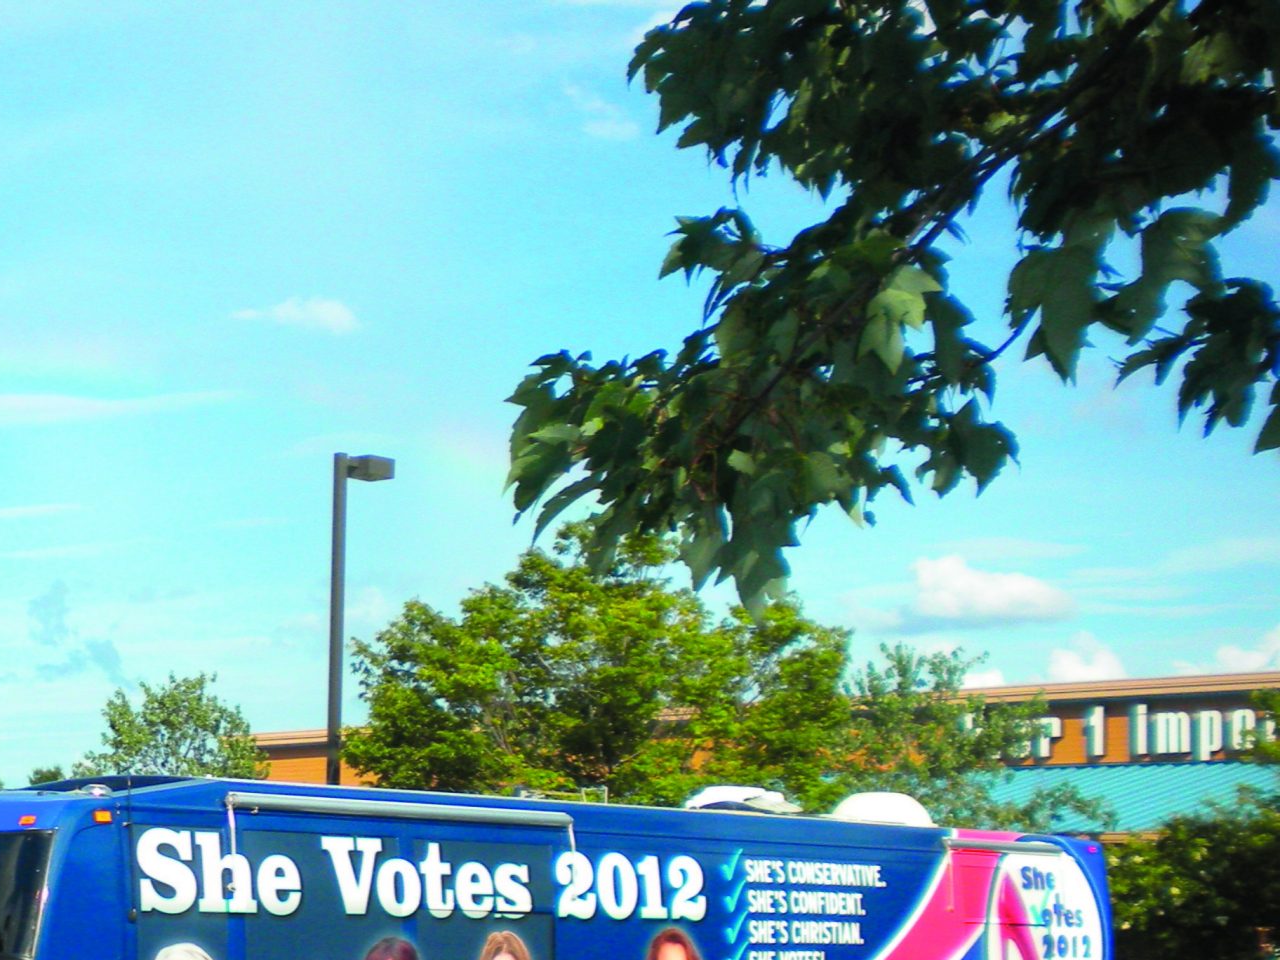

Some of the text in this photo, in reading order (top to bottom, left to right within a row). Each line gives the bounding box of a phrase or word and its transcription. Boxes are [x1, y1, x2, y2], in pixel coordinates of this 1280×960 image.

[1090, 705, 1105, 756] 1
[136, 827, 708, 922] She Votes 2012
[744, 858, 887, 888] SHE'S CONSERVATIVE.
[1020, 866, 1056, 891] She
[747, 889, 867, 916] SHE'S CONFIDENT.
[748, 920, 865, 945] SHE'S CHRISTIAN.
[1041, 934, 1092, 959] 2012
